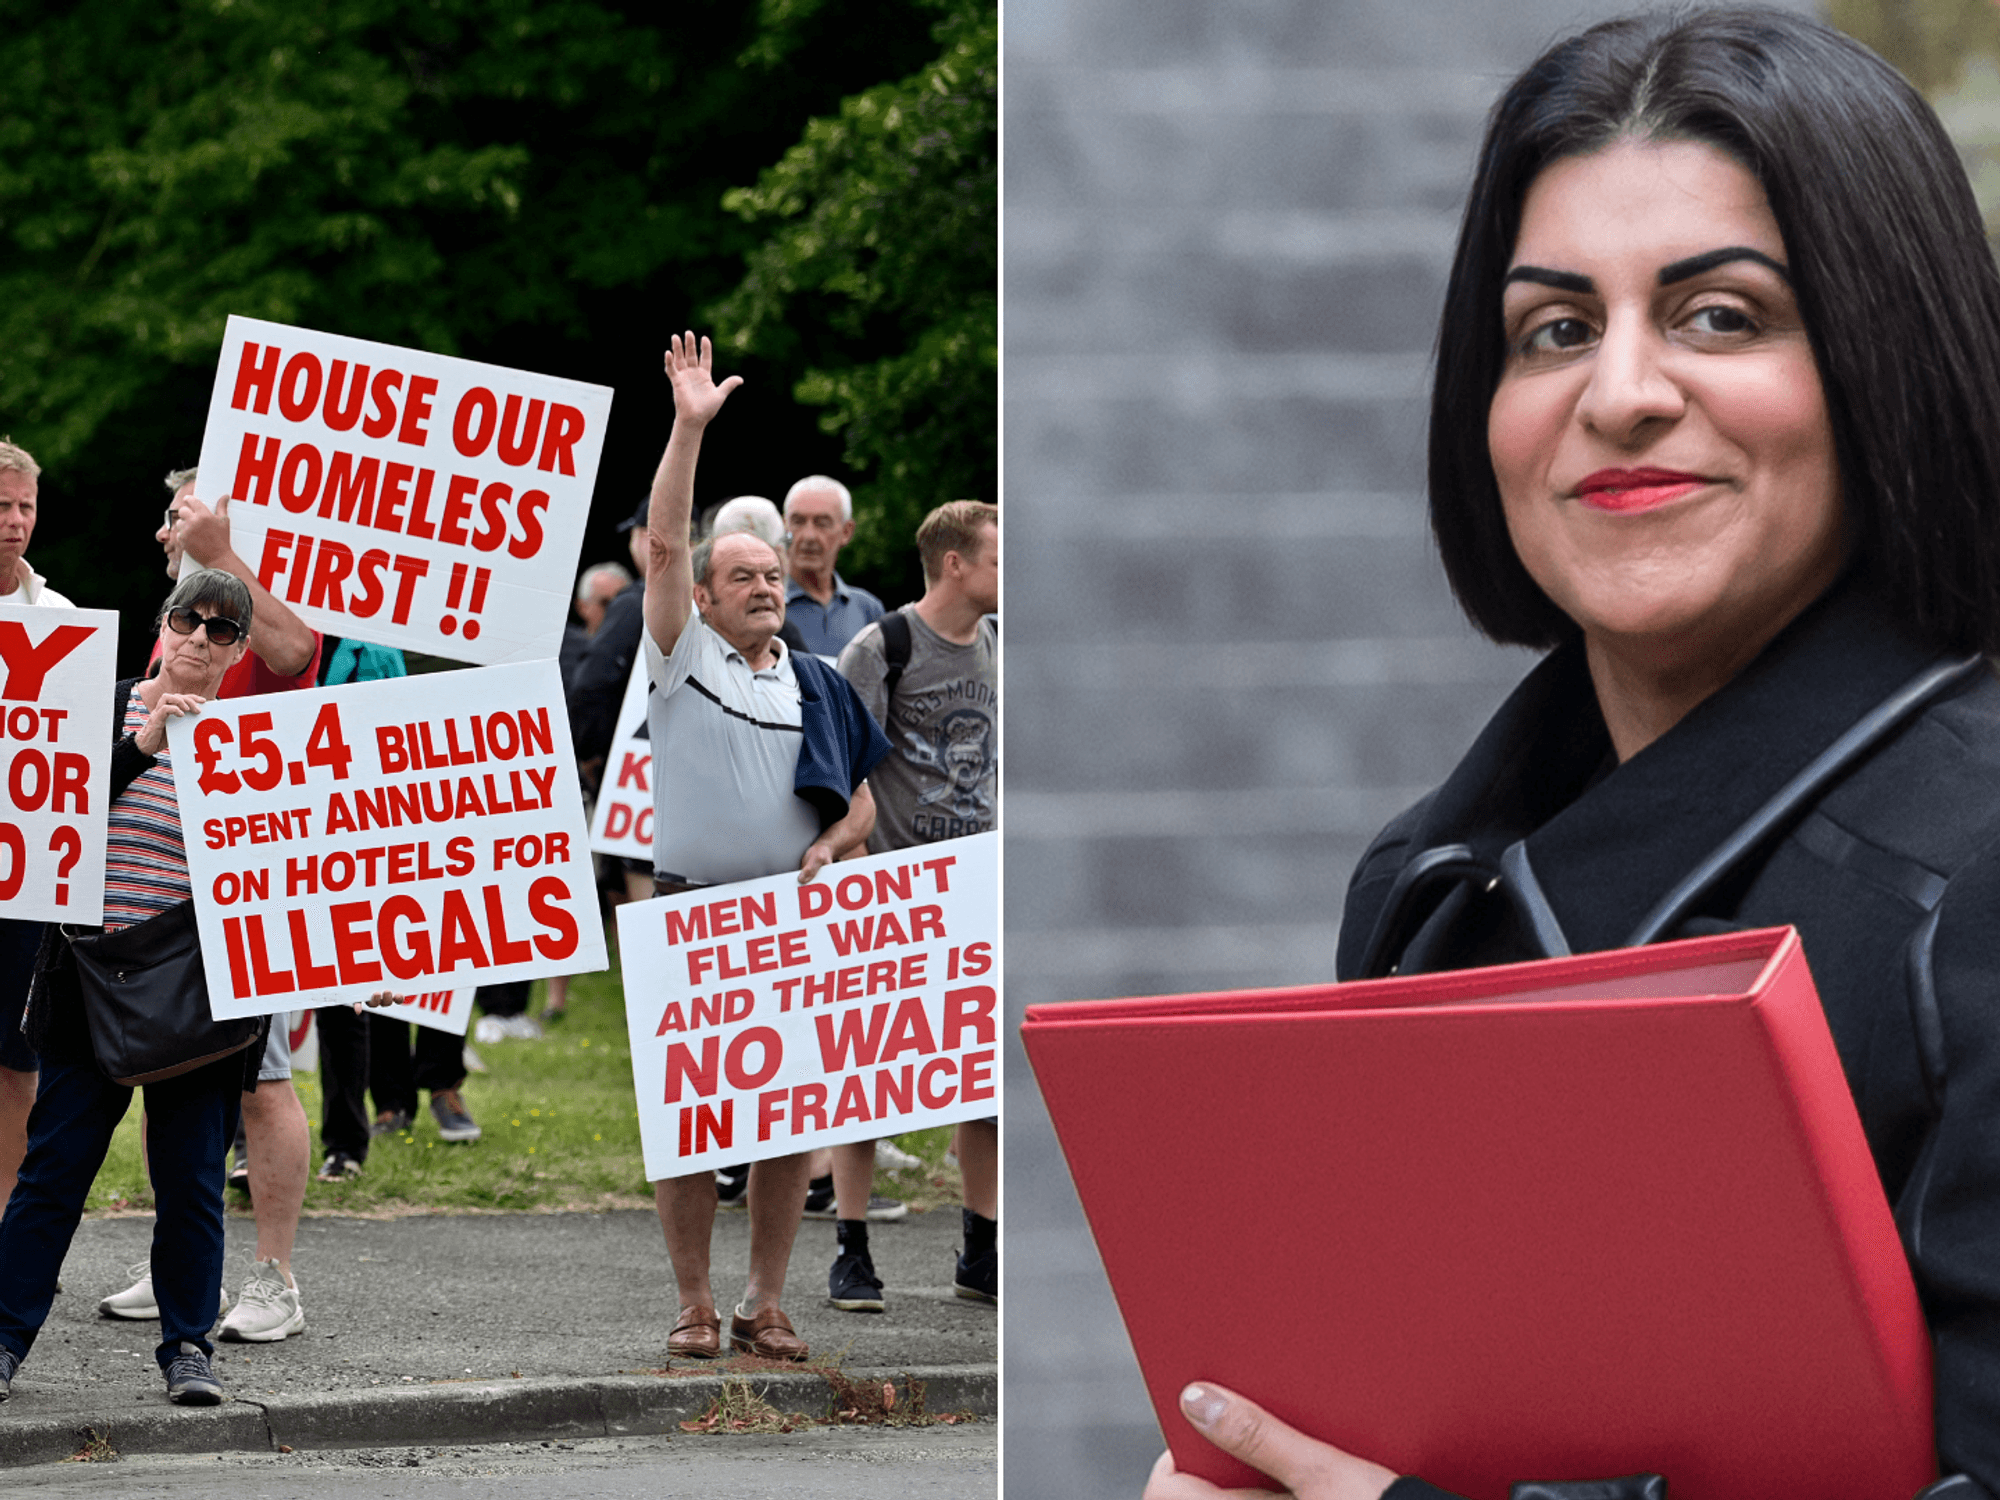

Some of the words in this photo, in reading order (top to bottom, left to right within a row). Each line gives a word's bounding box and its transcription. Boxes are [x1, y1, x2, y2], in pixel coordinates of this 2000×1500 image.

[231, 341, 439, 446] HOUSE
[453, 387, 585, 476] OUR
[231, 432, 550, 559] HOMELESS
[257, 528, 430, 625] FIRST
[440, 563, 492, 640] !!
[194, 703, 352, 796] £5.4
[376, 707, 554, 774] BILLION
[902, 690, 942, 726] GAS
[204, 808, 312, 849] SPENT
[326, 766, 557, 835] ANNUALLY
[213, 868, 269, 905] ON
[287, 836, 475, 897] HOTELS
[494, 832, 570, 871] FOR
[665, 892, 777, 945] MEN
[797, 856, 956, 919] DON'T
[223, 876, 579, 999] ILLEGALS
[687, 929, 811, 985] FLEE
[828, 905, 946, 956] WAR
[656, 989, 755, 1036] AND
[773, 954, 928, 1013] THERE
[947, 942, 992, 980] IS
[664, 1026, 783, 1104] NO
[815, 986, 997, 1073] WAR
[679, 1099, 734, 1157] IN
[757, 1049, 995, 1142] FRANCE
